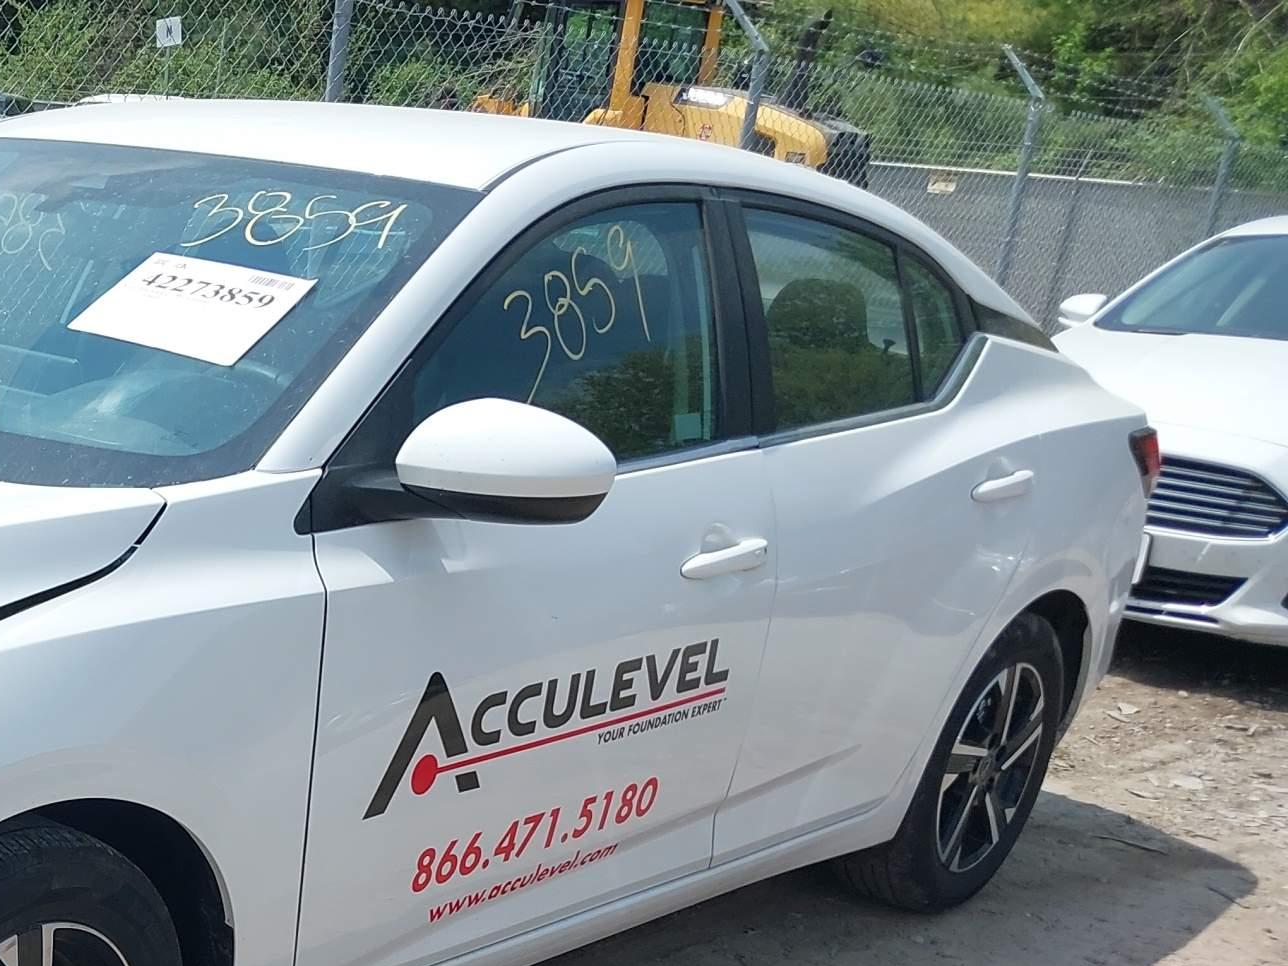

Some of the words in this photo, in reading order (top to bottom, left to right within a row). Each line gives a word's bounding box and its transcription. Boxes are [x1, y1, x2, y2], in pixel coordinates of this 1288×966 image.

[180, 190, 408, 251] 3859
[141, 272, 276, 308] 42273859
[503, 224, 652, 404] 3859
[362, 637, 730, 820] ACCULEVEL
[597, 726, 625, 744] YOUR
[627, 708, 690, 737] FOUNDATION
[691, 698, 723, 718] EXPERT
[411, 777, 659, 893] 866.471.5180
[428, 843, 618, 923] www.acculevel.com
